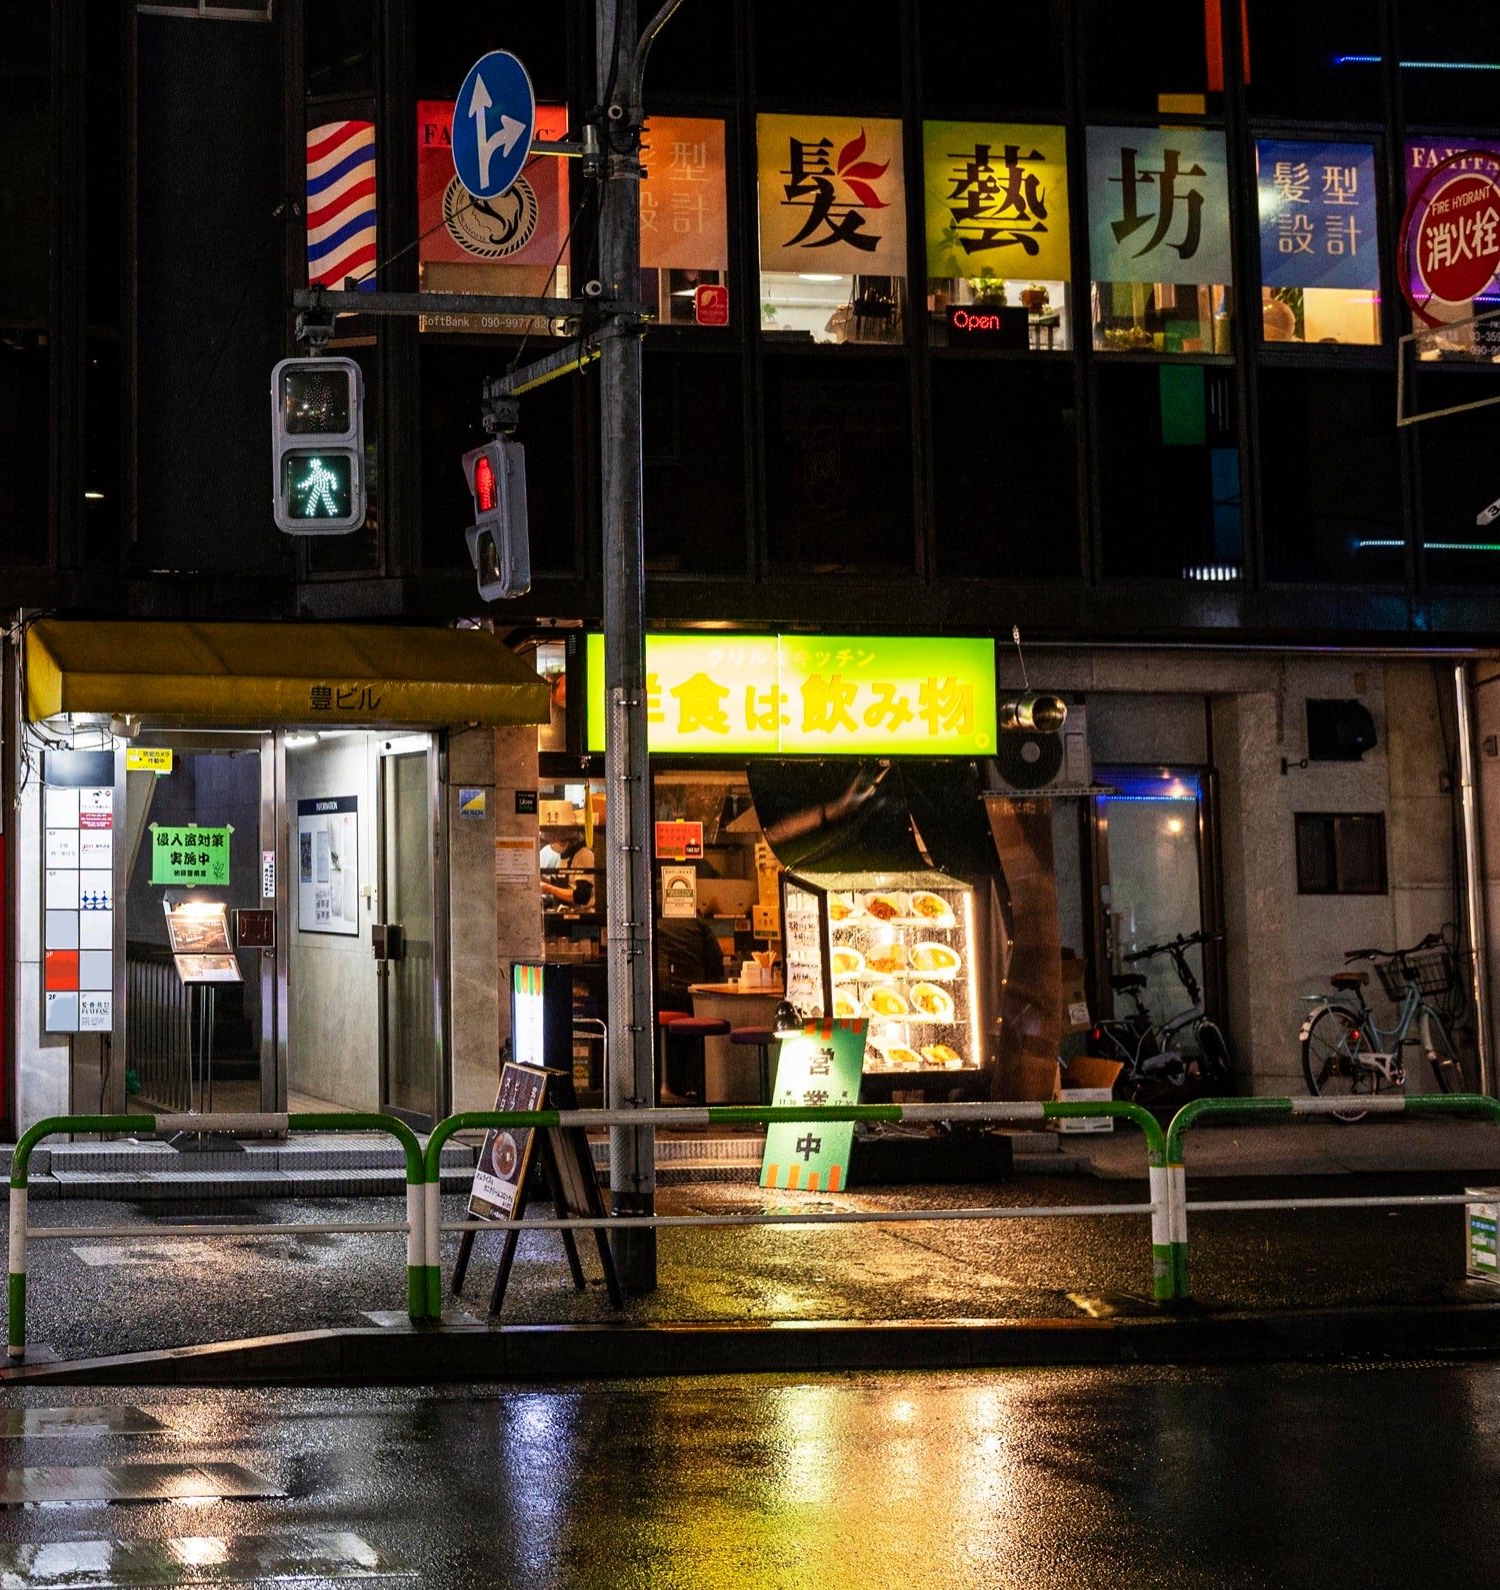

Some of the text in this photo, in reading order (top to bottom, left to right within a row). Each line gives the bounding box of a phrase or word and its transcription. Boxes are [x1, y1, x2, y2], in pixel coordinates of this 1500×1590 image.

[1107, 147, 1207, 260] 坊
[1431, 185, 1491, 217] FIRE HYDRANT
[1278, 212, 1362, 256] 設計
[1426, 206, 1500, 273] 消火栓
[422, 315, 470, 328] SoftBank
[954, 309, 1001, 331] Open
[309, 686, 381, 711] 豊ビル
[519, 798, 534, 806] Uber
[156, 833, 225, 848] 侵入盗対策
[170, 852, 210, 866] 実施中
